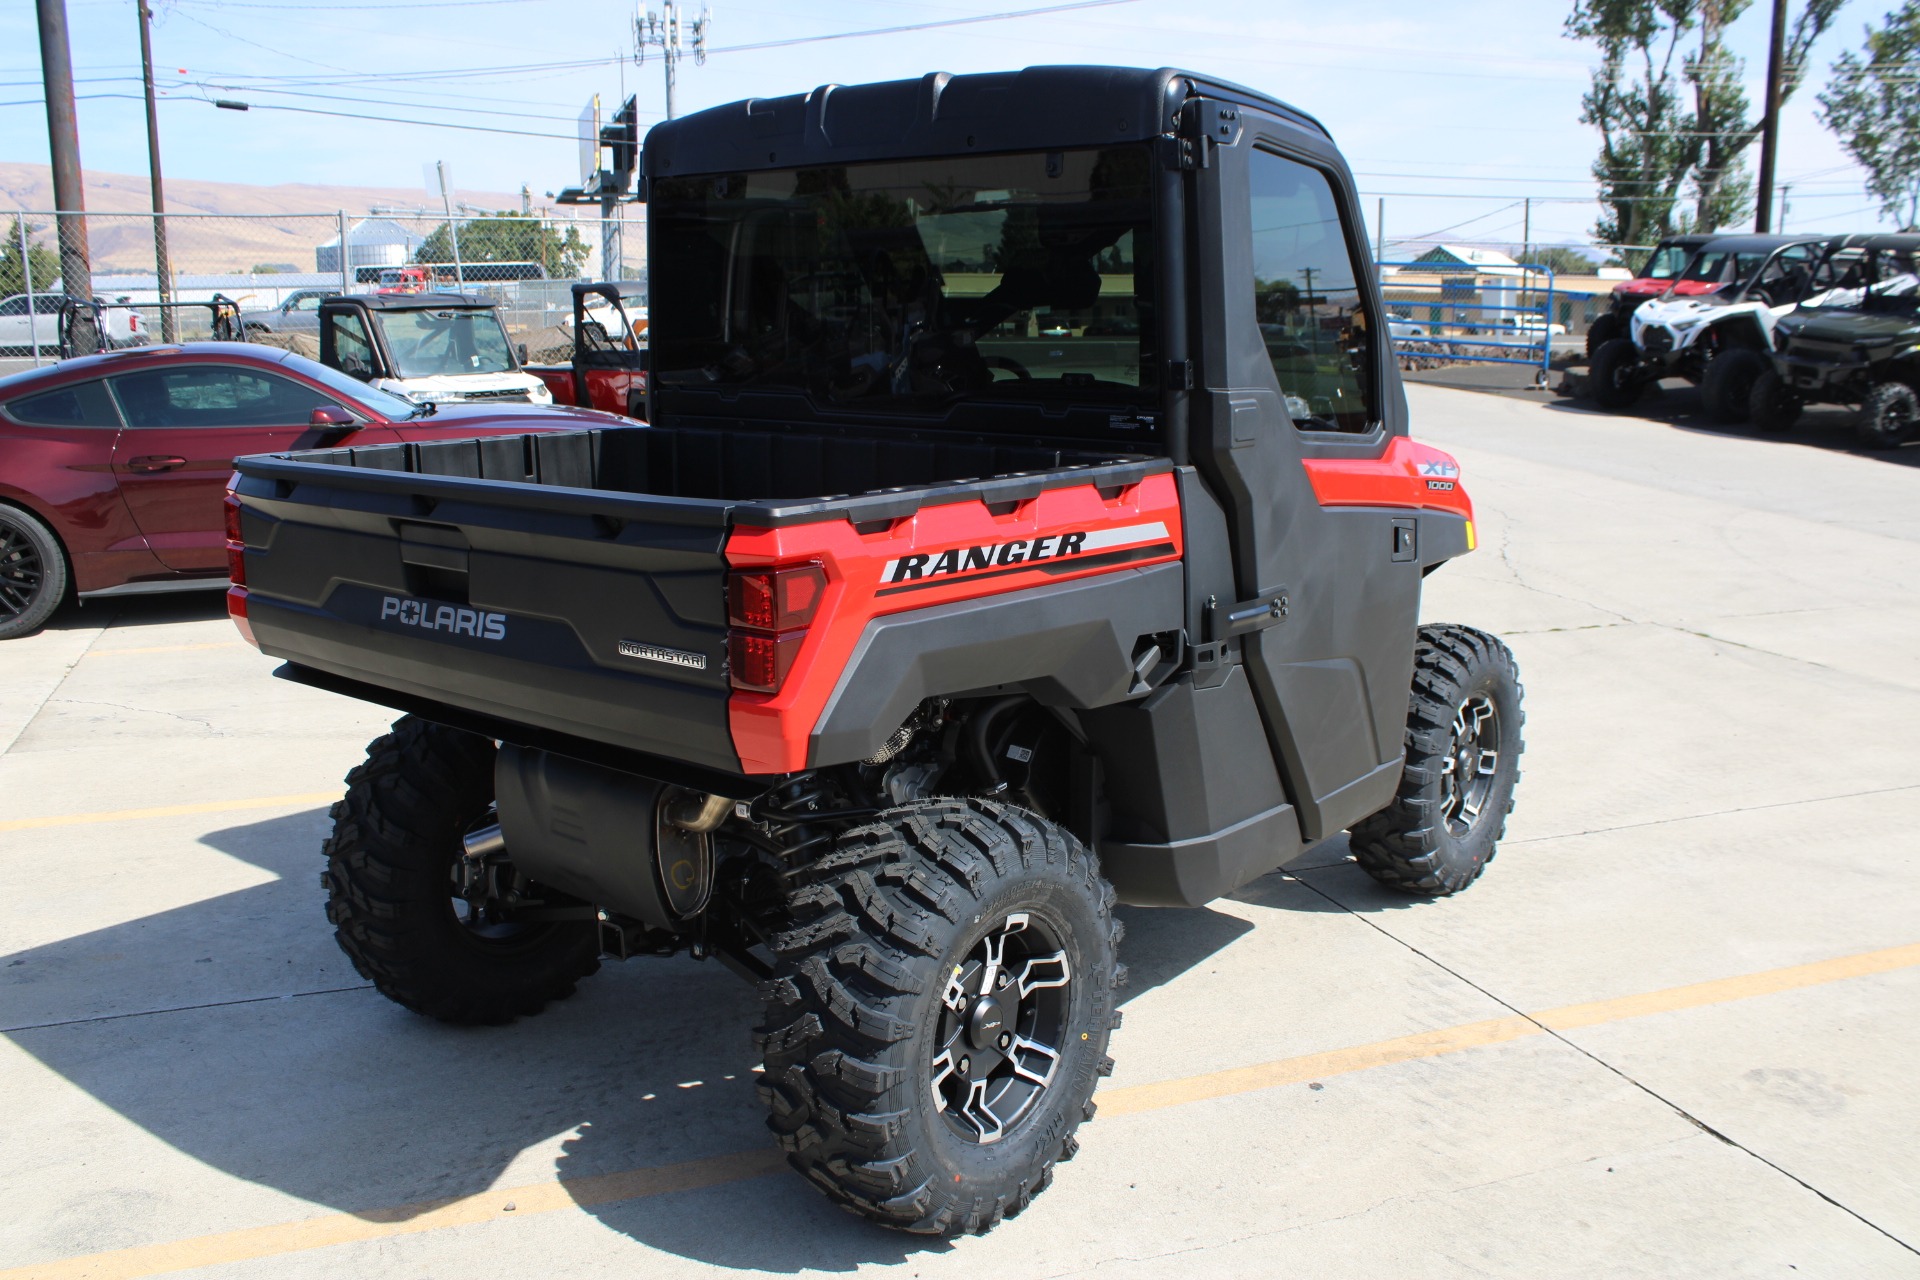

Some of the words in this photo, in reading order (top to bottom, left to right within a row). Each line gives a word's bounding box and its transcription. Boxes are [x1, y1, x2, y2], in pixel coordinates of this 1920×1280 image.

[1424, 459, 1456, 475] XP
[1428, 481, 1453, 490] 1000
[891, 531, 1086, 583] RANGER
[381, 596, 506, 640] POLARIS
[621, 642, 701, 666] NORTHSTAR
